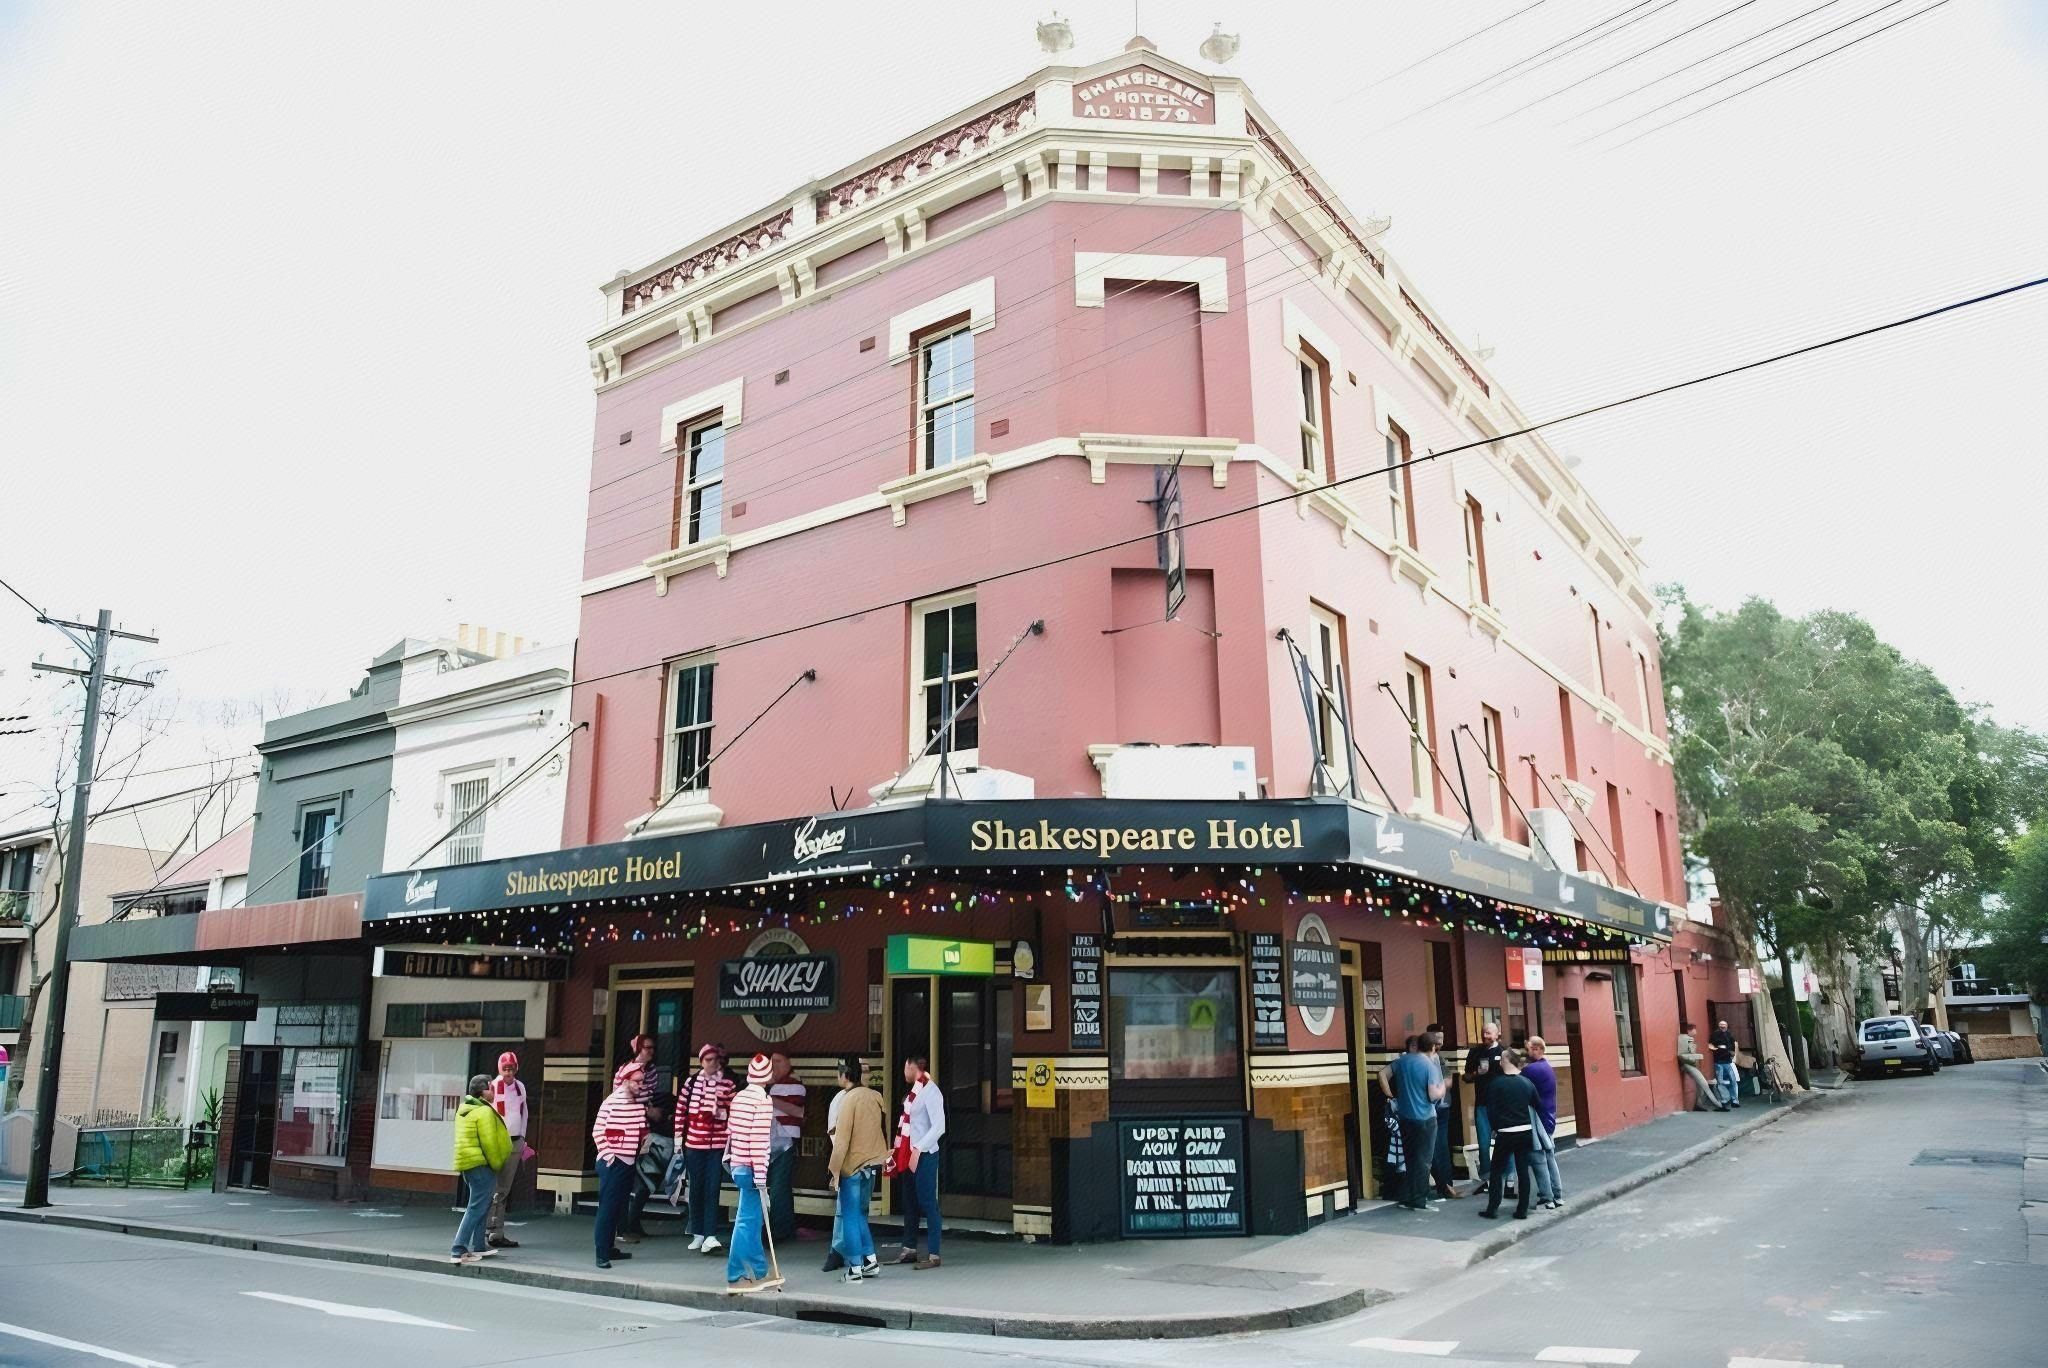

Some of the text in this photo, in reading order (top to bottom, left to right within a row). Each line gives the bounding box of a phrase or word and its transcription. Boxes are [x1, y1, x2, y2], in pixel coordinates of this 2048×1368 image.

[1114, 91, 1192, 107] HOTEL
[971, 818, 1305, 858] Shakespeare Hotel
[505, 851, 681, 896] Shakespeare Hotel
[733, 960, 825, 997] SHAKEY
